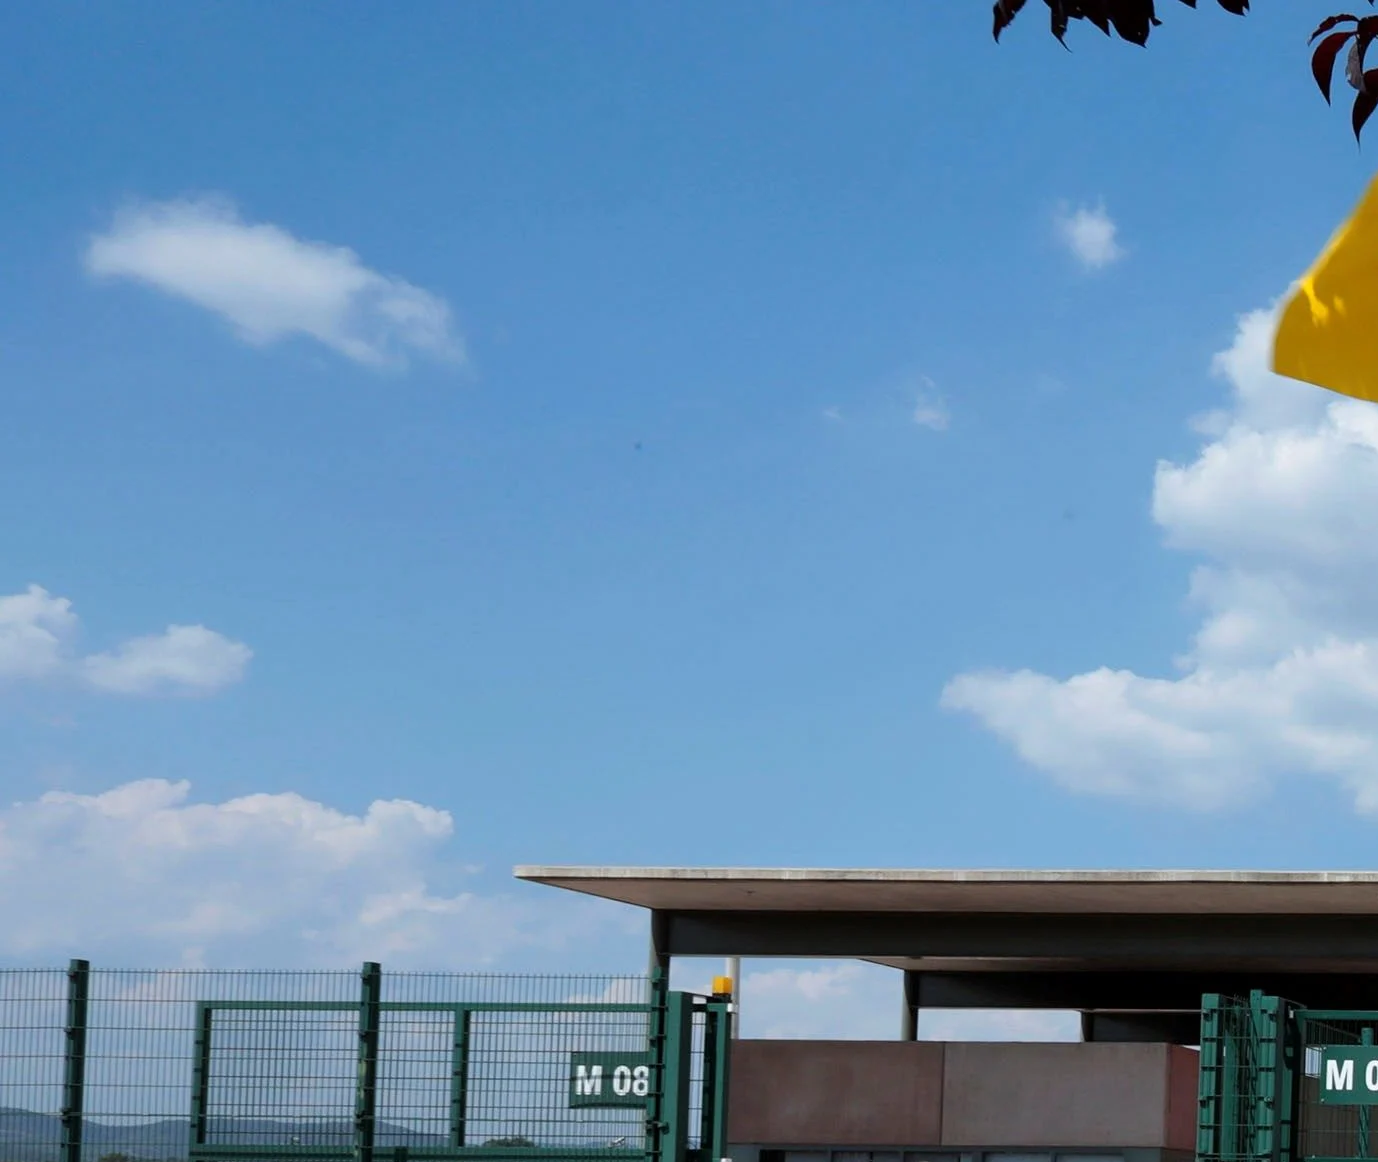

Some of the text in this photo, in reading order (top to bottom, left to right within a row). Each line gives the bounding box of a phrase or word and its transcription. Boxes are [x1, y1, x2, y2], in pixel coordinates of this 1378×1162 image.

[575, 1065, 649, 1096] M 08
[1326, 1060, 1354, 1090] M
